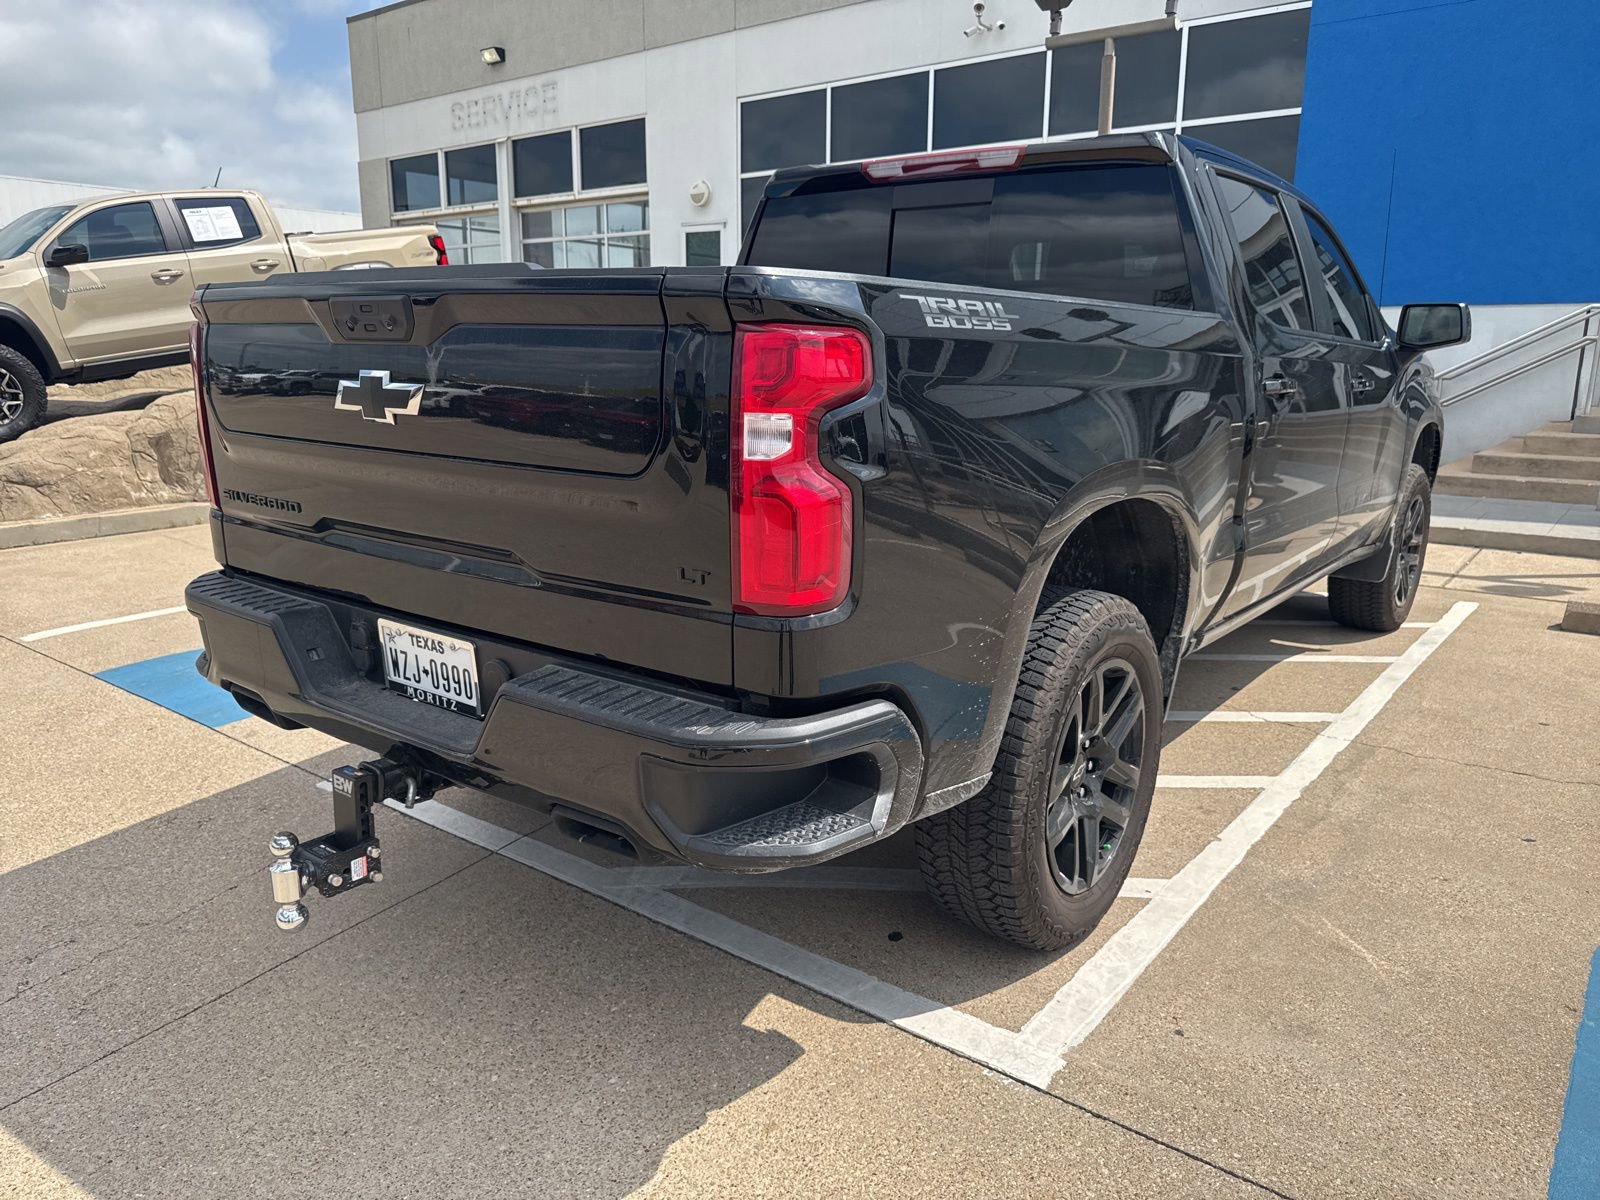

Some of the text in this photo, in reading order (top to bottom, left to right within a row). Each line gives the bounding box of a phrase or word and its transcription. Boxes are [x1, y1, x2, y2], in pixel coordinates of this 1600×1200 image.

[451, 81, 558, 130] SERVICE
[897, 293, 1019, 319] TRAIL
[924, 313, 1012, 331] BOSS
[679, 567, 712, 585] LT
[408, 633, 445, 655] TEXAS
[406, 686, 458, 711] MORITZ
